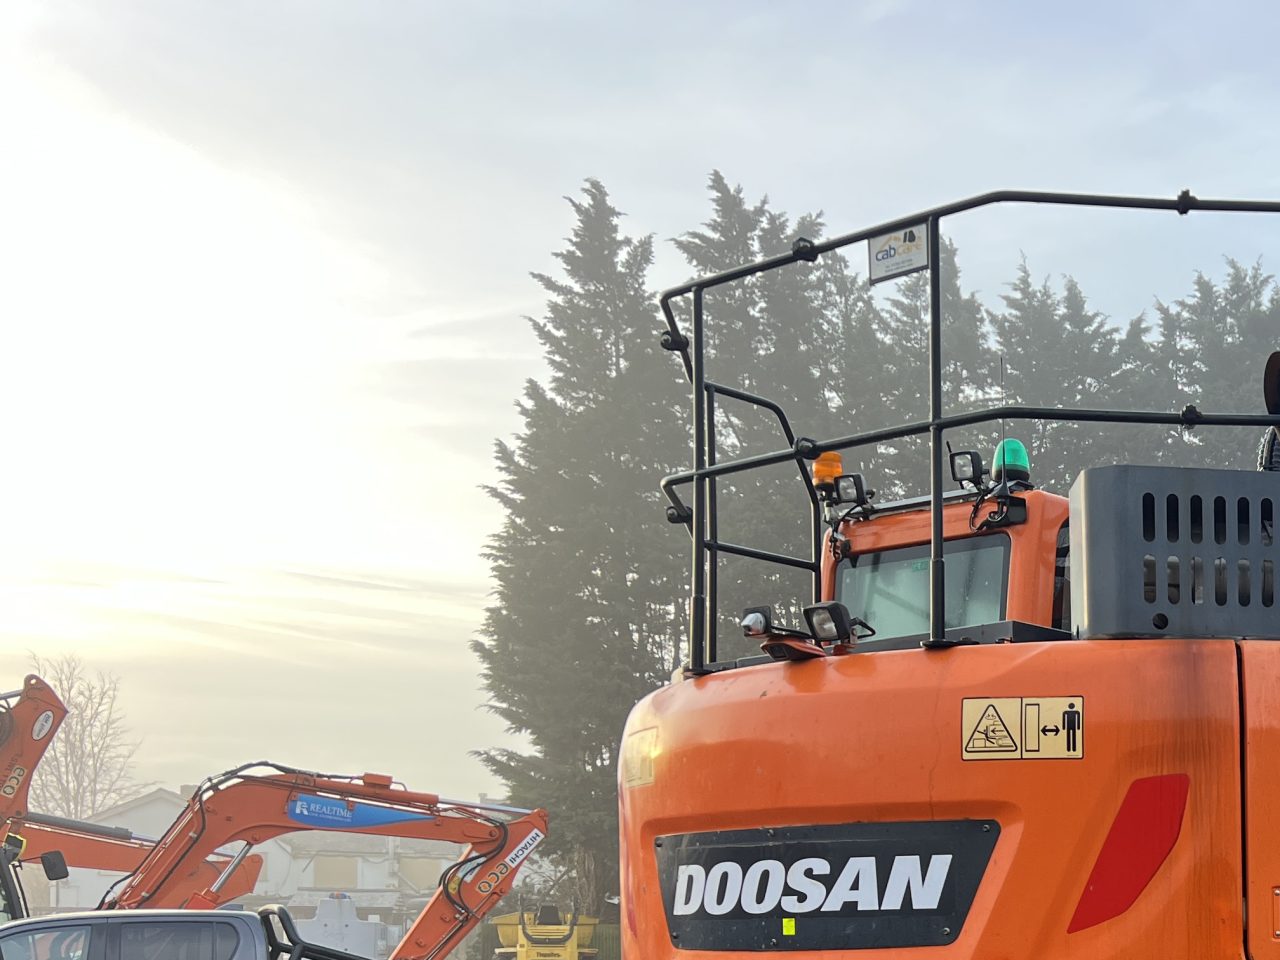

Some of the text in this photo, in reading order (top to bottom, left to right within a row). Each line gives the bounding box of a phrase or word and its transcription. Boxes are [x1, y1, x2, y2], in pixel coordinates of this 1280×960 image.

[3, 767, 25, 795] eco
[309, 803, 353, 818] REALTIME
[509, 832, 541, 865] HITACHI
[477, 862, 509, 893] eco
[673, 854, 953, 916] DOOSAN
